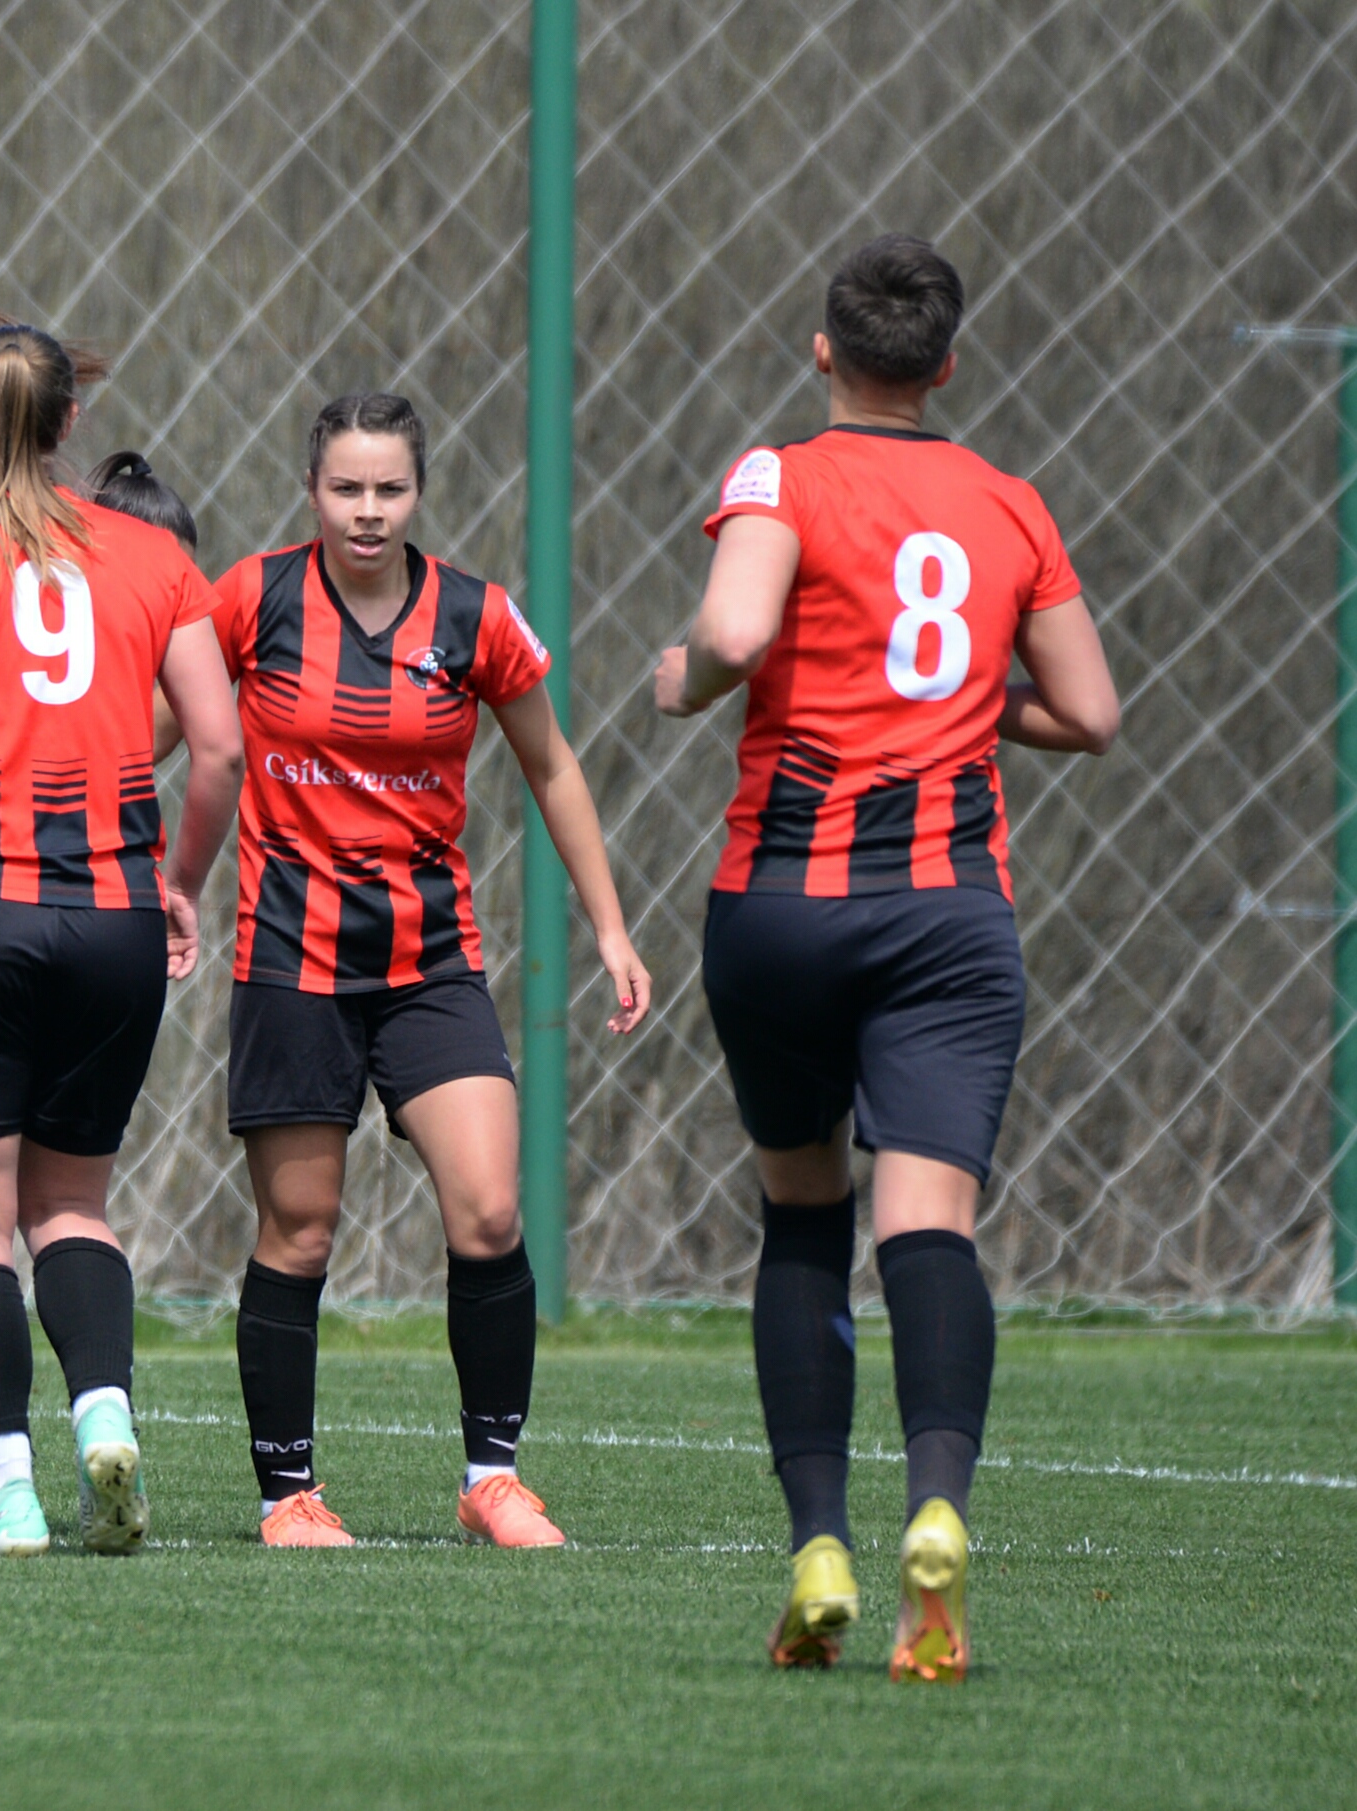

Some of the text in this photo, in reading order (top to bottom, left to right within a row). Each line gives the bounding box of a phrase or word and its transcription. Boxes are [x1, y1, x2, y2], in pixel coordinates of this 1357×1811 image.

[12, 558, 95, 705] 9
[885, 531, 971, 701] 8
[265, 753, 441, 793] Csíkszereda
